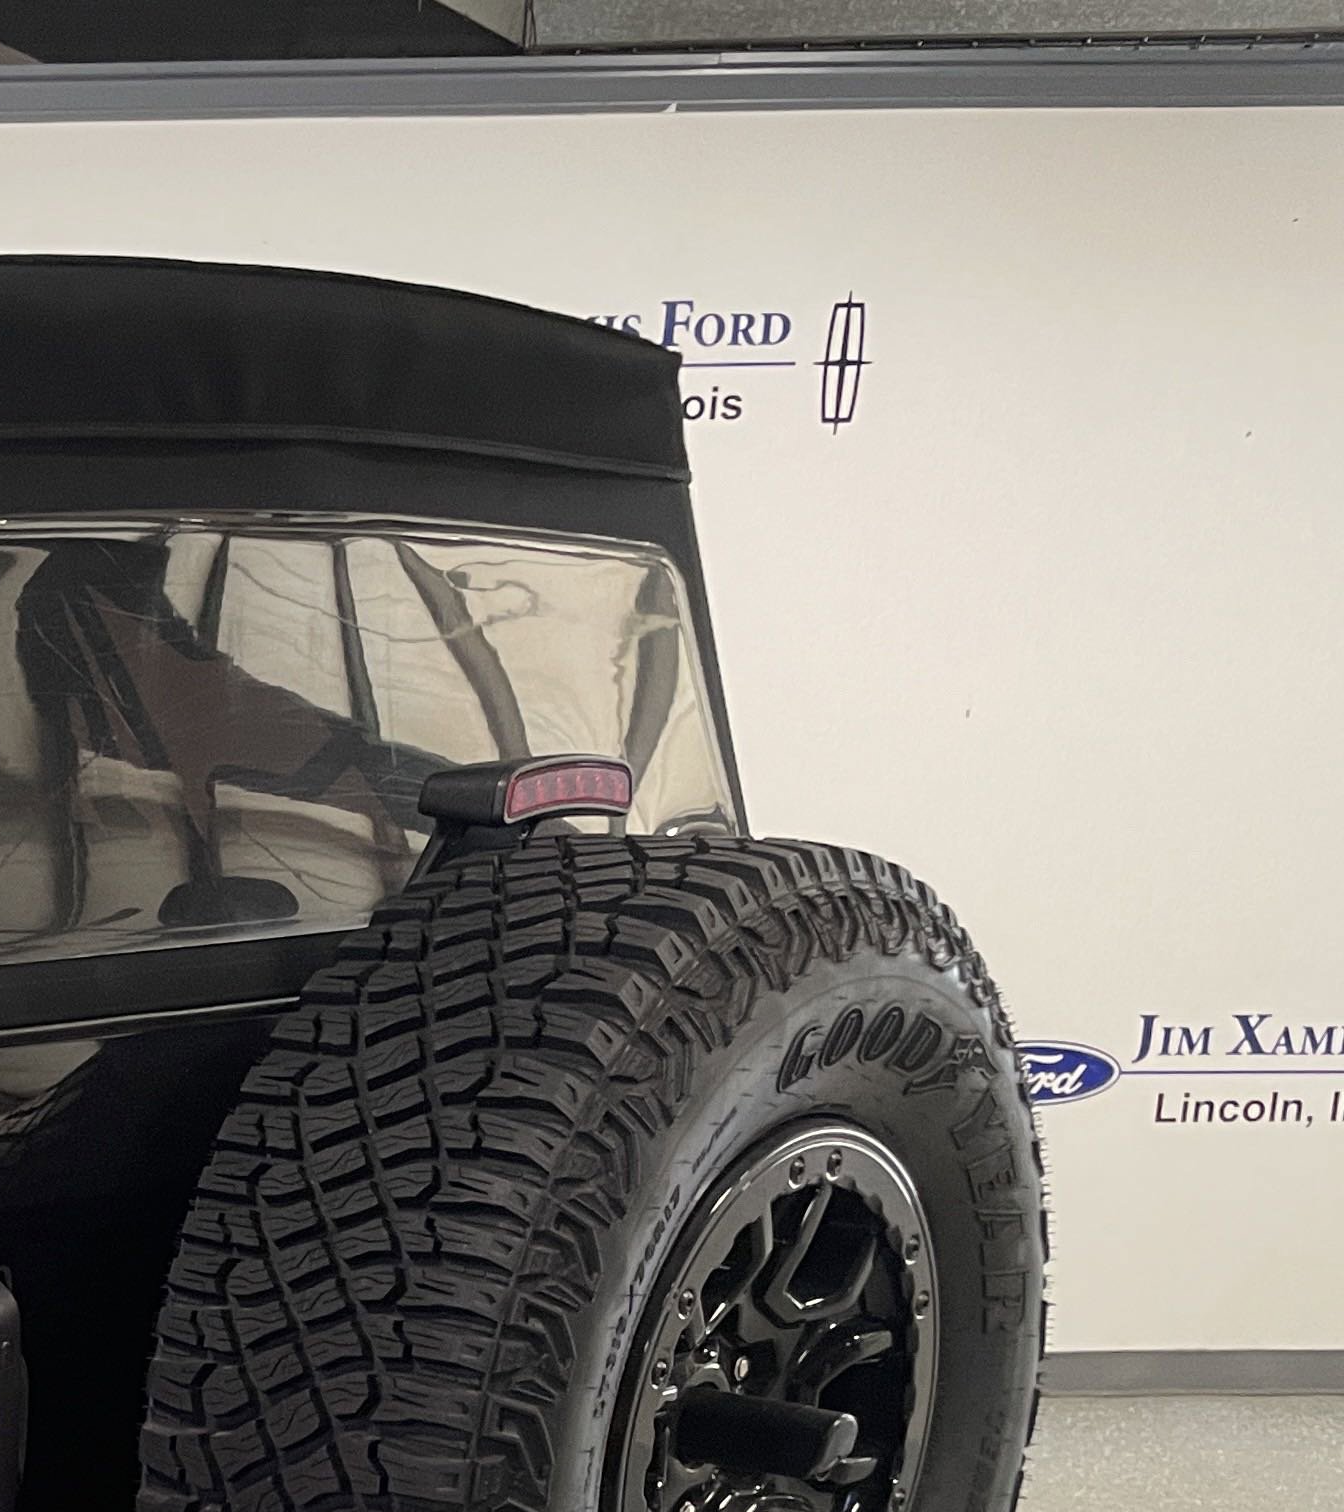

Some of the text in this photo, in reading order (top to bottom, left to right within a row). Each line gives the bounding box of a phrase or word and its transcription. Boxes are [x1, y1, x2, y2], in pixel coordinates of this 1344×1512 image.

[661, 299, 792, 348] FORD
[1131, 1013, 1344, 1063] JIM XAM
[1155, 1091, 1313, 1127] Lincoln,
